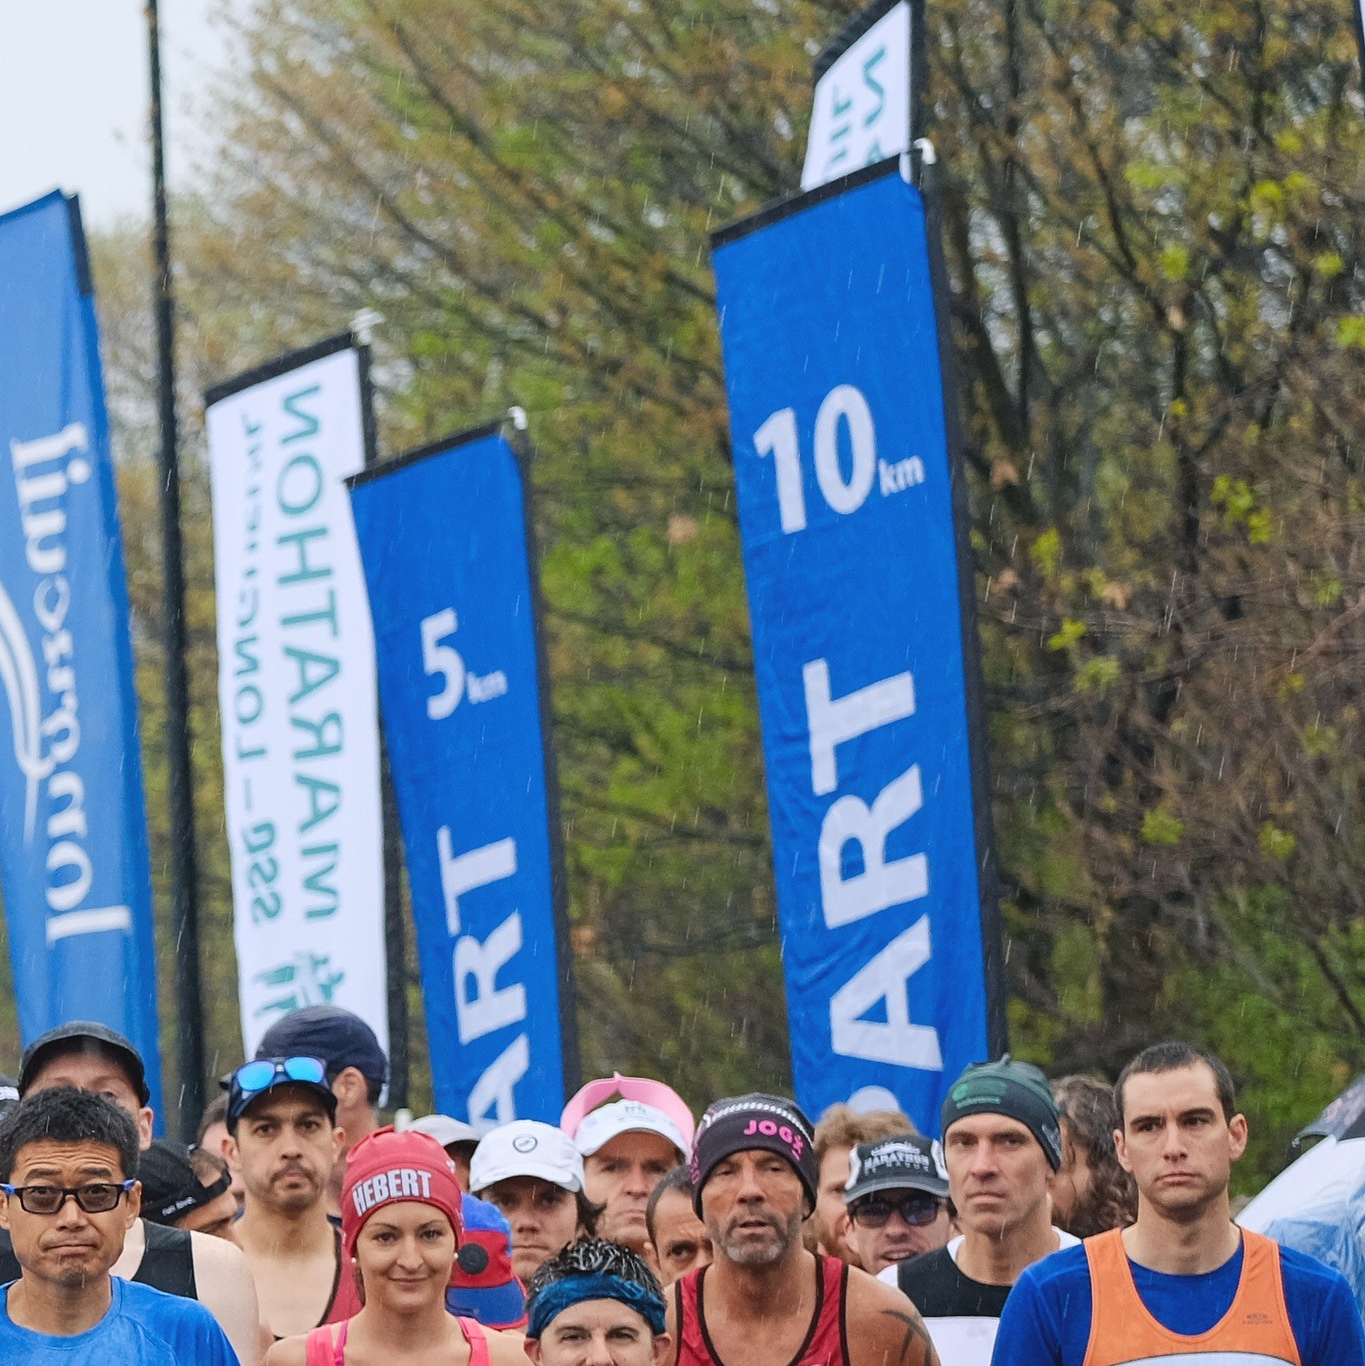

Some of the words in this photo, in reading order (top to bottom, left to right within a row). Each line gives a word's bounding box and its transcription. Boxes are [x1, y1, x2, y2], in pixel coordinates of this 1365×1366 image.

[753, 383, 877, 534] 10
[878, 454, 925, 497] km
[420, 606, 467, 721] 5
[803, 657, 943, 1113] ART
[352, 1168, 432, 1217] HEBERT
